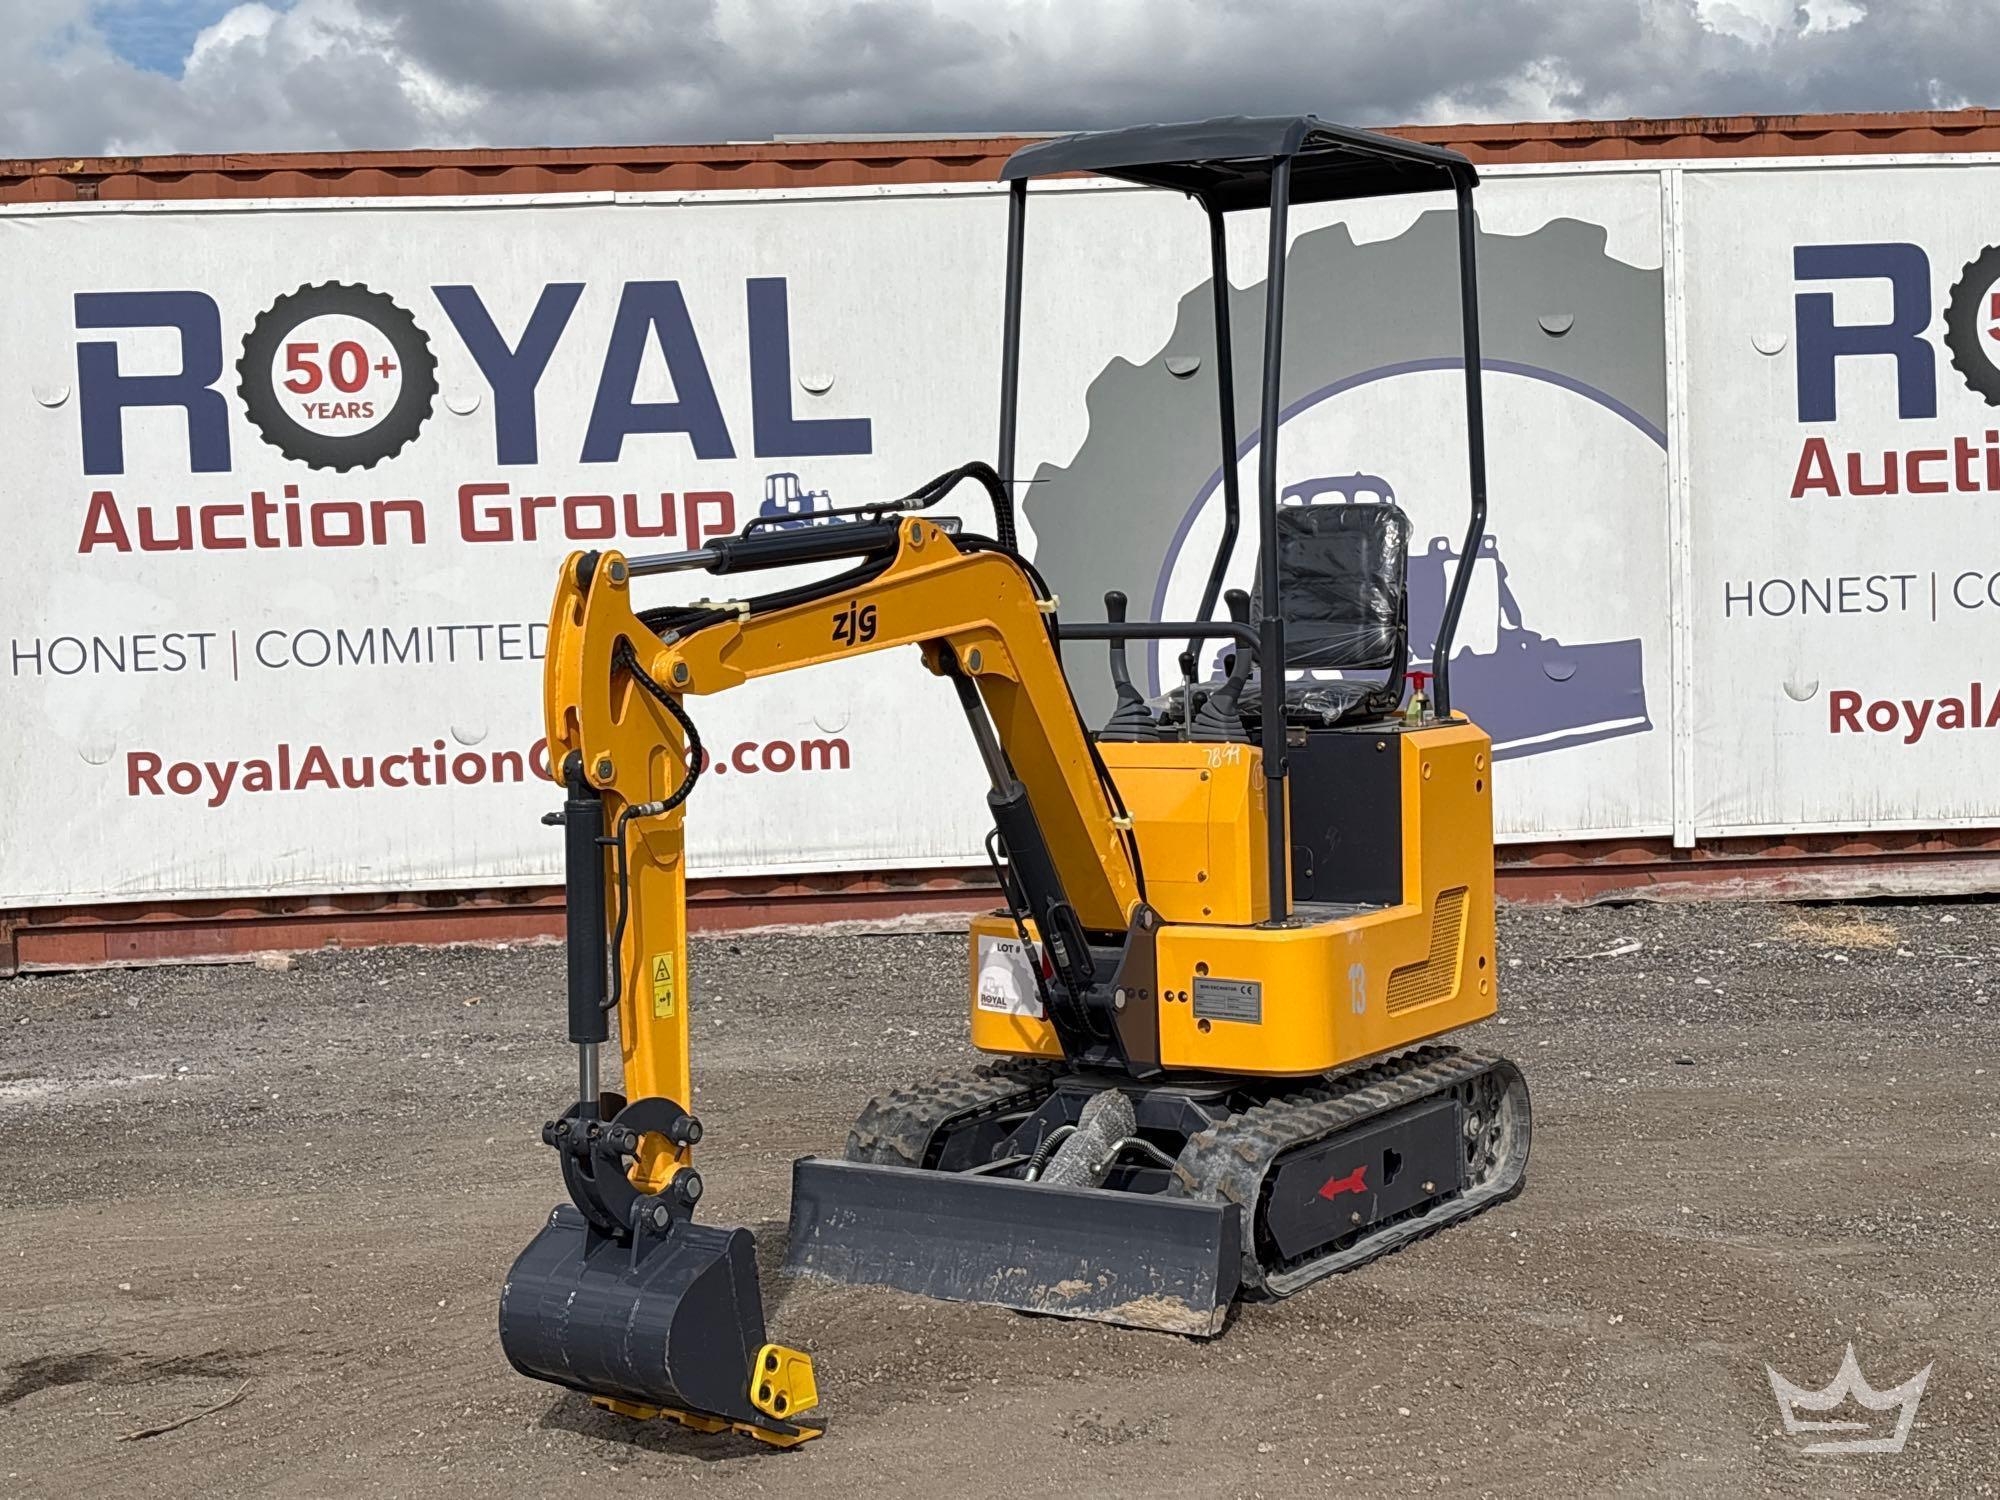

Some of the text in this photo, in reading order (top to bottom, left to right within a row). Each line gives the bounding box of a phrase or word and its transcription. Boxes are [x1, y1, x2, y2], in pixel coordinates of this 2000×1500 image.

[74, 277, 873, 475] ROYAL
[283, 340, 398, 394] 50+
[302, 400, 375, 421] YEARS
[78, 482, 736, 554] Auction Group
[1725, 575, 1917, 618] HONEST
[832, 601, 877, 647] zjg
[12, 623, 549, 676] HONEST COMMITTED
[997, 943, 1014, 954] LOT
[981, 994, 1007, 1006] ROYAL
